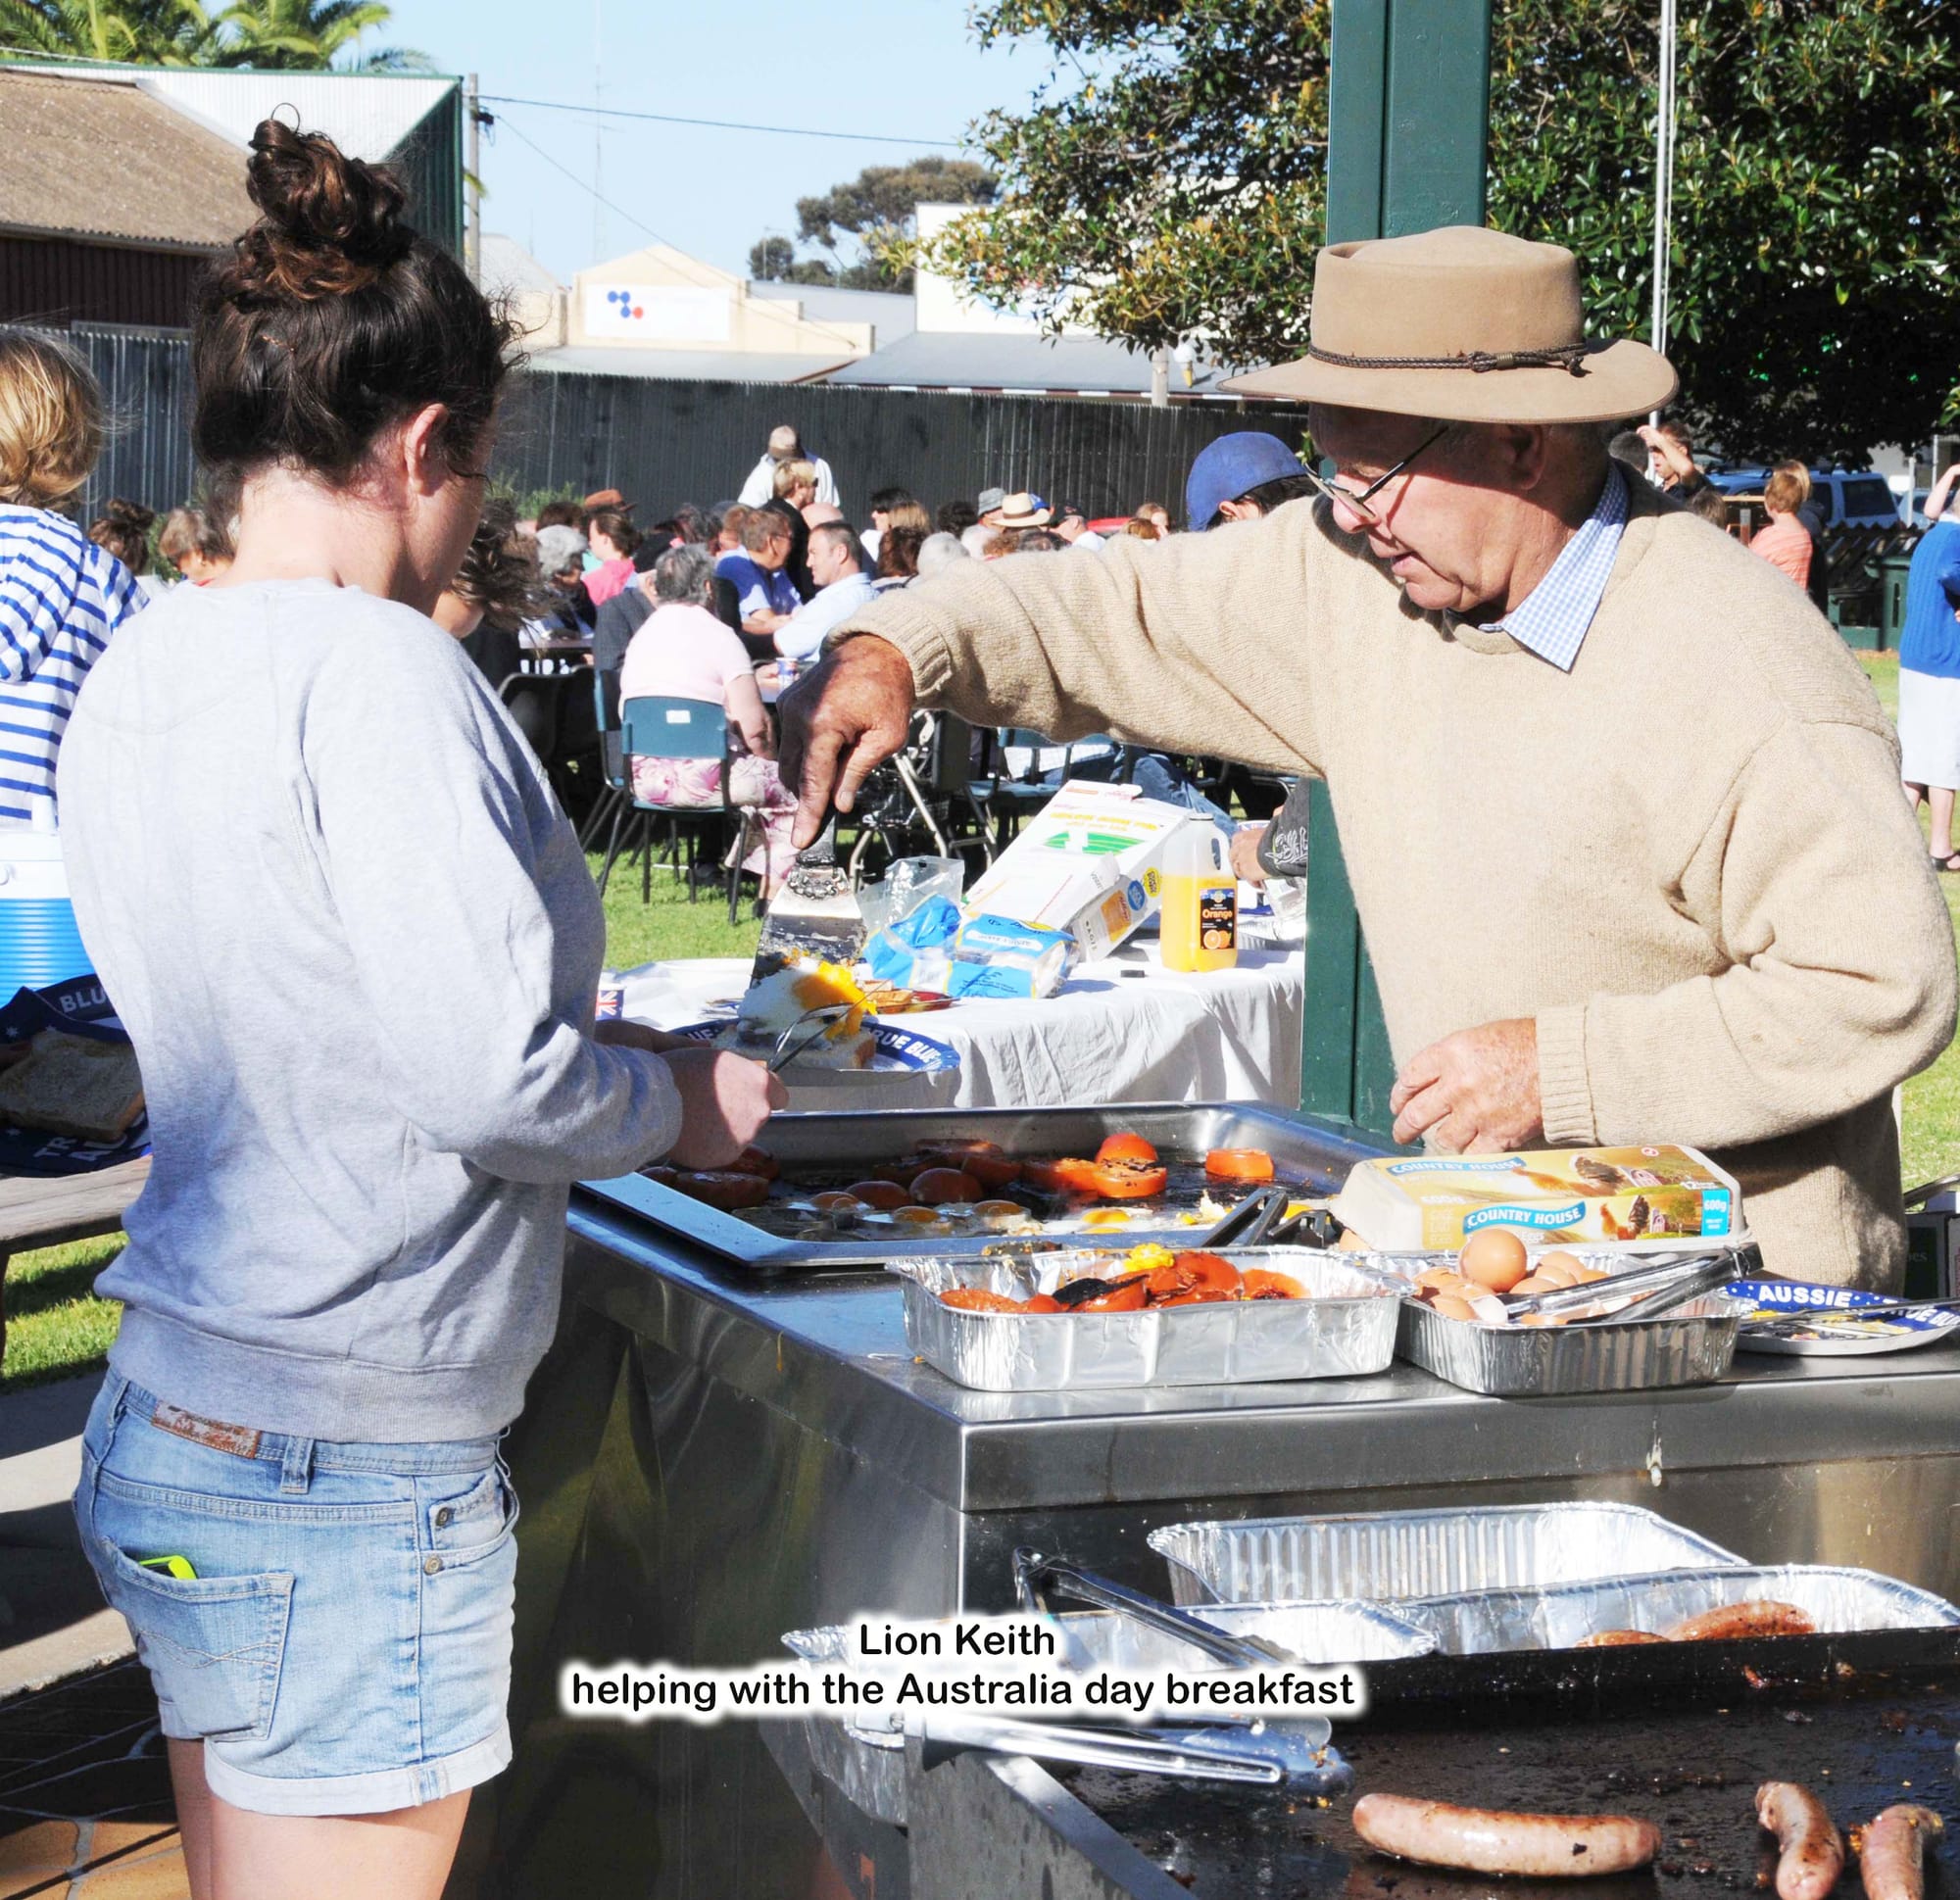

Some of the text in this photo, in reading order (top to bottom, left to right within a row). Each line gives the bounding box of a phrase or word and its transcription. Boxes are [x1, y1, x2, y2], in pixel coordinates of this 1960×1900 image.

[1201, 908, 1234, 920] Orange
[59, 988, 108, 1013] BLU
[1392, 1157, 1523, 1174] COUNTRY HOUSE
[1467, 1207, 1533, 1228] COUNTRY
[1535, 1205, 1583, 1226] HOUSE
[1758, 1285, 1851, 1308] AUSSIE
